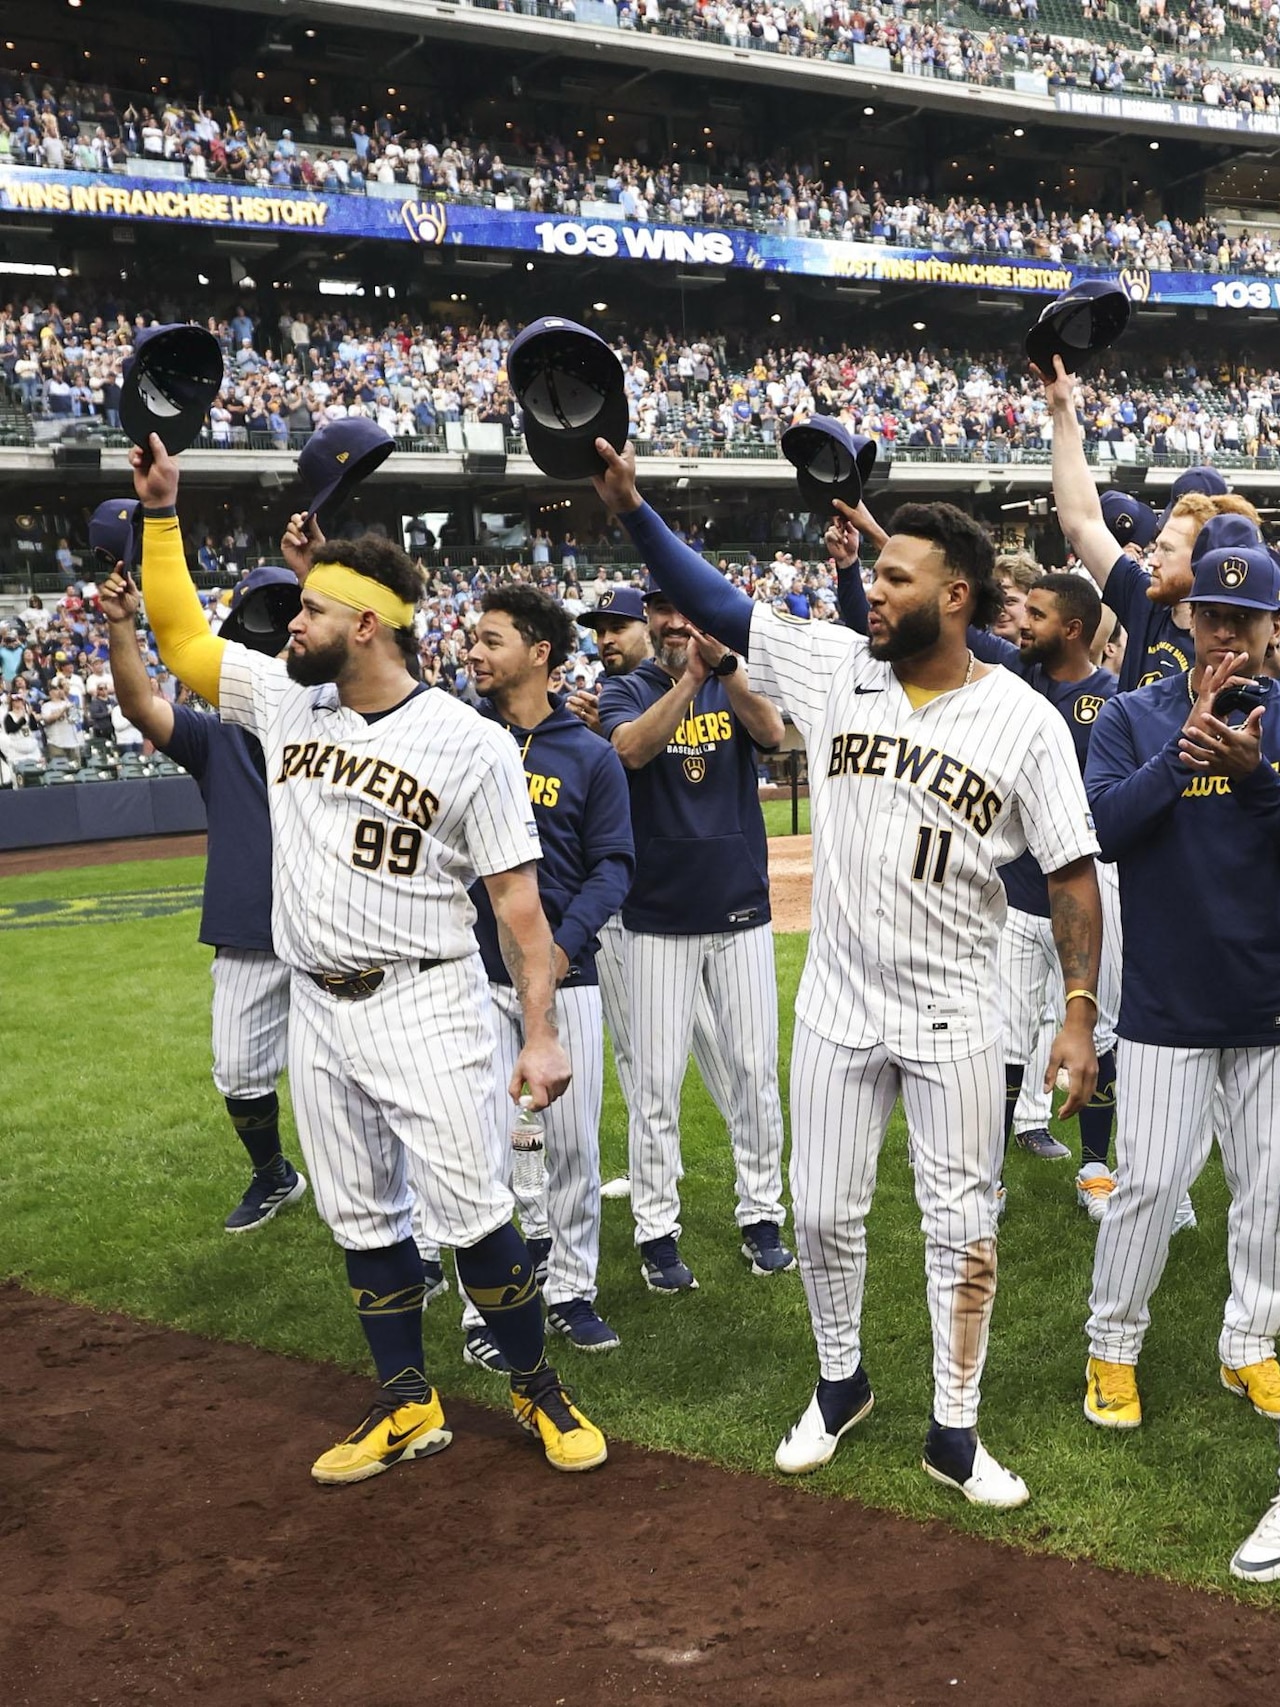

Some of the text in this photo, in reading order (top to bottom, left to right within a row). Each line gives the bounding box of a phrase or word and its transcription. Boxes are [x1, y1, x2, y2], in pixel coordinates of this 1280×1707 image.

[5, 182, 328, 227] WINS IN FRANCHISE HISTORY
[535, 221, 735, 265] 103 WINS
[880, 258, 916, 281] WINS
[916, 259, 931, 282] IN
[931, 261, 1012, 287] FRANCHISE
[1013, 267, 1072, 290] HISTORY
[1212, 281, 1272, 309] 103
[666, 744, 703, 756] BASEBALL
[276, 741, 441, 831] BREWERS
[827, 732, 1003, 838] BREWERS
[352, 817, 423, 876] 99
[911, 825, 953, 884] 11
